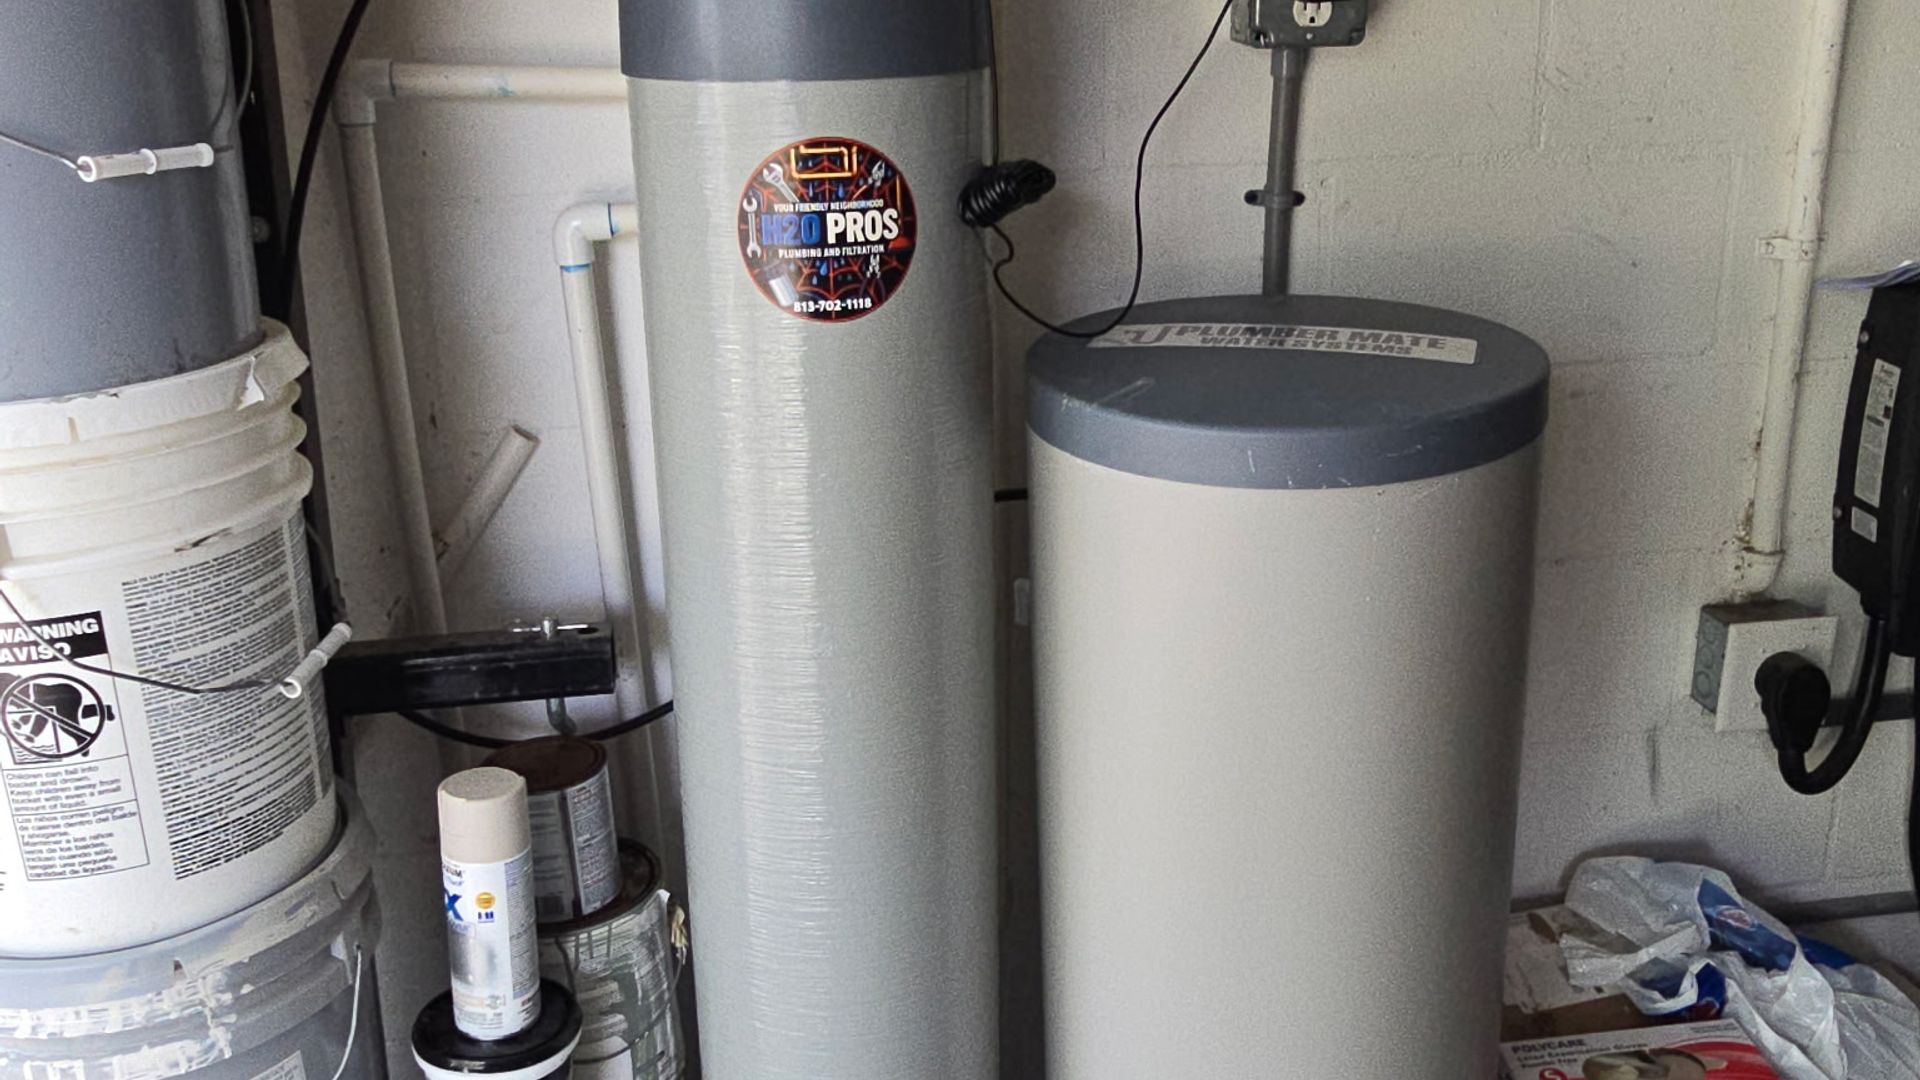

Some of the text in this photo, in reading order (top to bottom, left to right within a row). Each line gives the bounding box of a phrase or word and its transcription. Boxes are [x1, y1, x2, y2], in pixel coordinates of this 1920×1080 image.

[773, 198, 884, 213] YOUR FRIENDLY NEIGHBORHOOD
[761, 207, 899, 246] H2O PROS
[778, 244, 885, 259] PLUMBING AND FILTRATION
[793, 297, 873, 313] 813-702-1118
[1173, 325, 1447, 350] PLUMBER MATE
[1199, 336, 1414, 355] WATER SYSTEMS
[1511, 1039, 1586, 1054] POLYCARE
